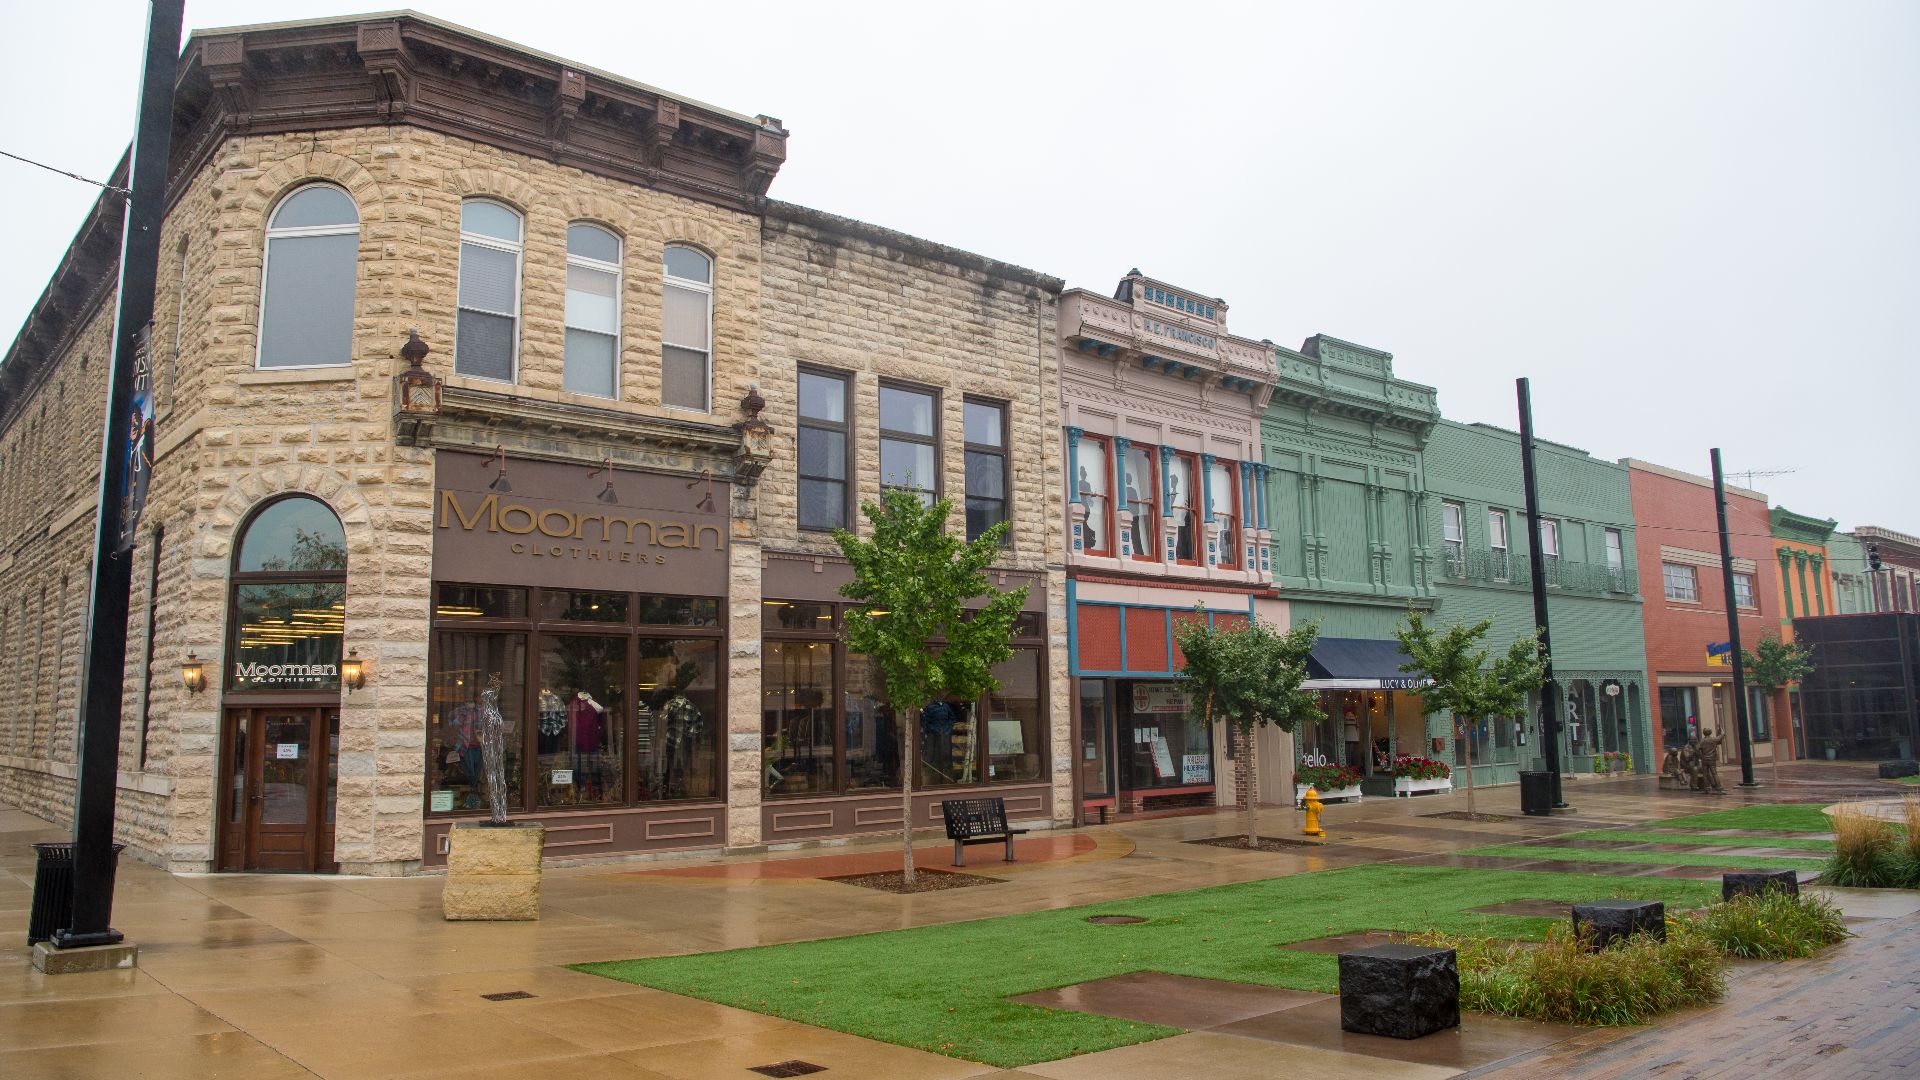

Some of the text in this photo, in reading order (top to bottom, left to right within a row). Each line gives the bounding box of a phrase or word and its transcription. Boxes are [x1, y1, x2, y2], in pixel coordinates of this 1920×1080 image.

[1163, 325, 1216, 351] FRANCISCO
[438, 489, 724, 551] Moorman
[511, 542, 666, 565] CLOTHIERS
[235, 662, 338, 677] Moorman
[1381, 679, 1399, 689] LUCY
[1400, 679, 1407, 689] &
